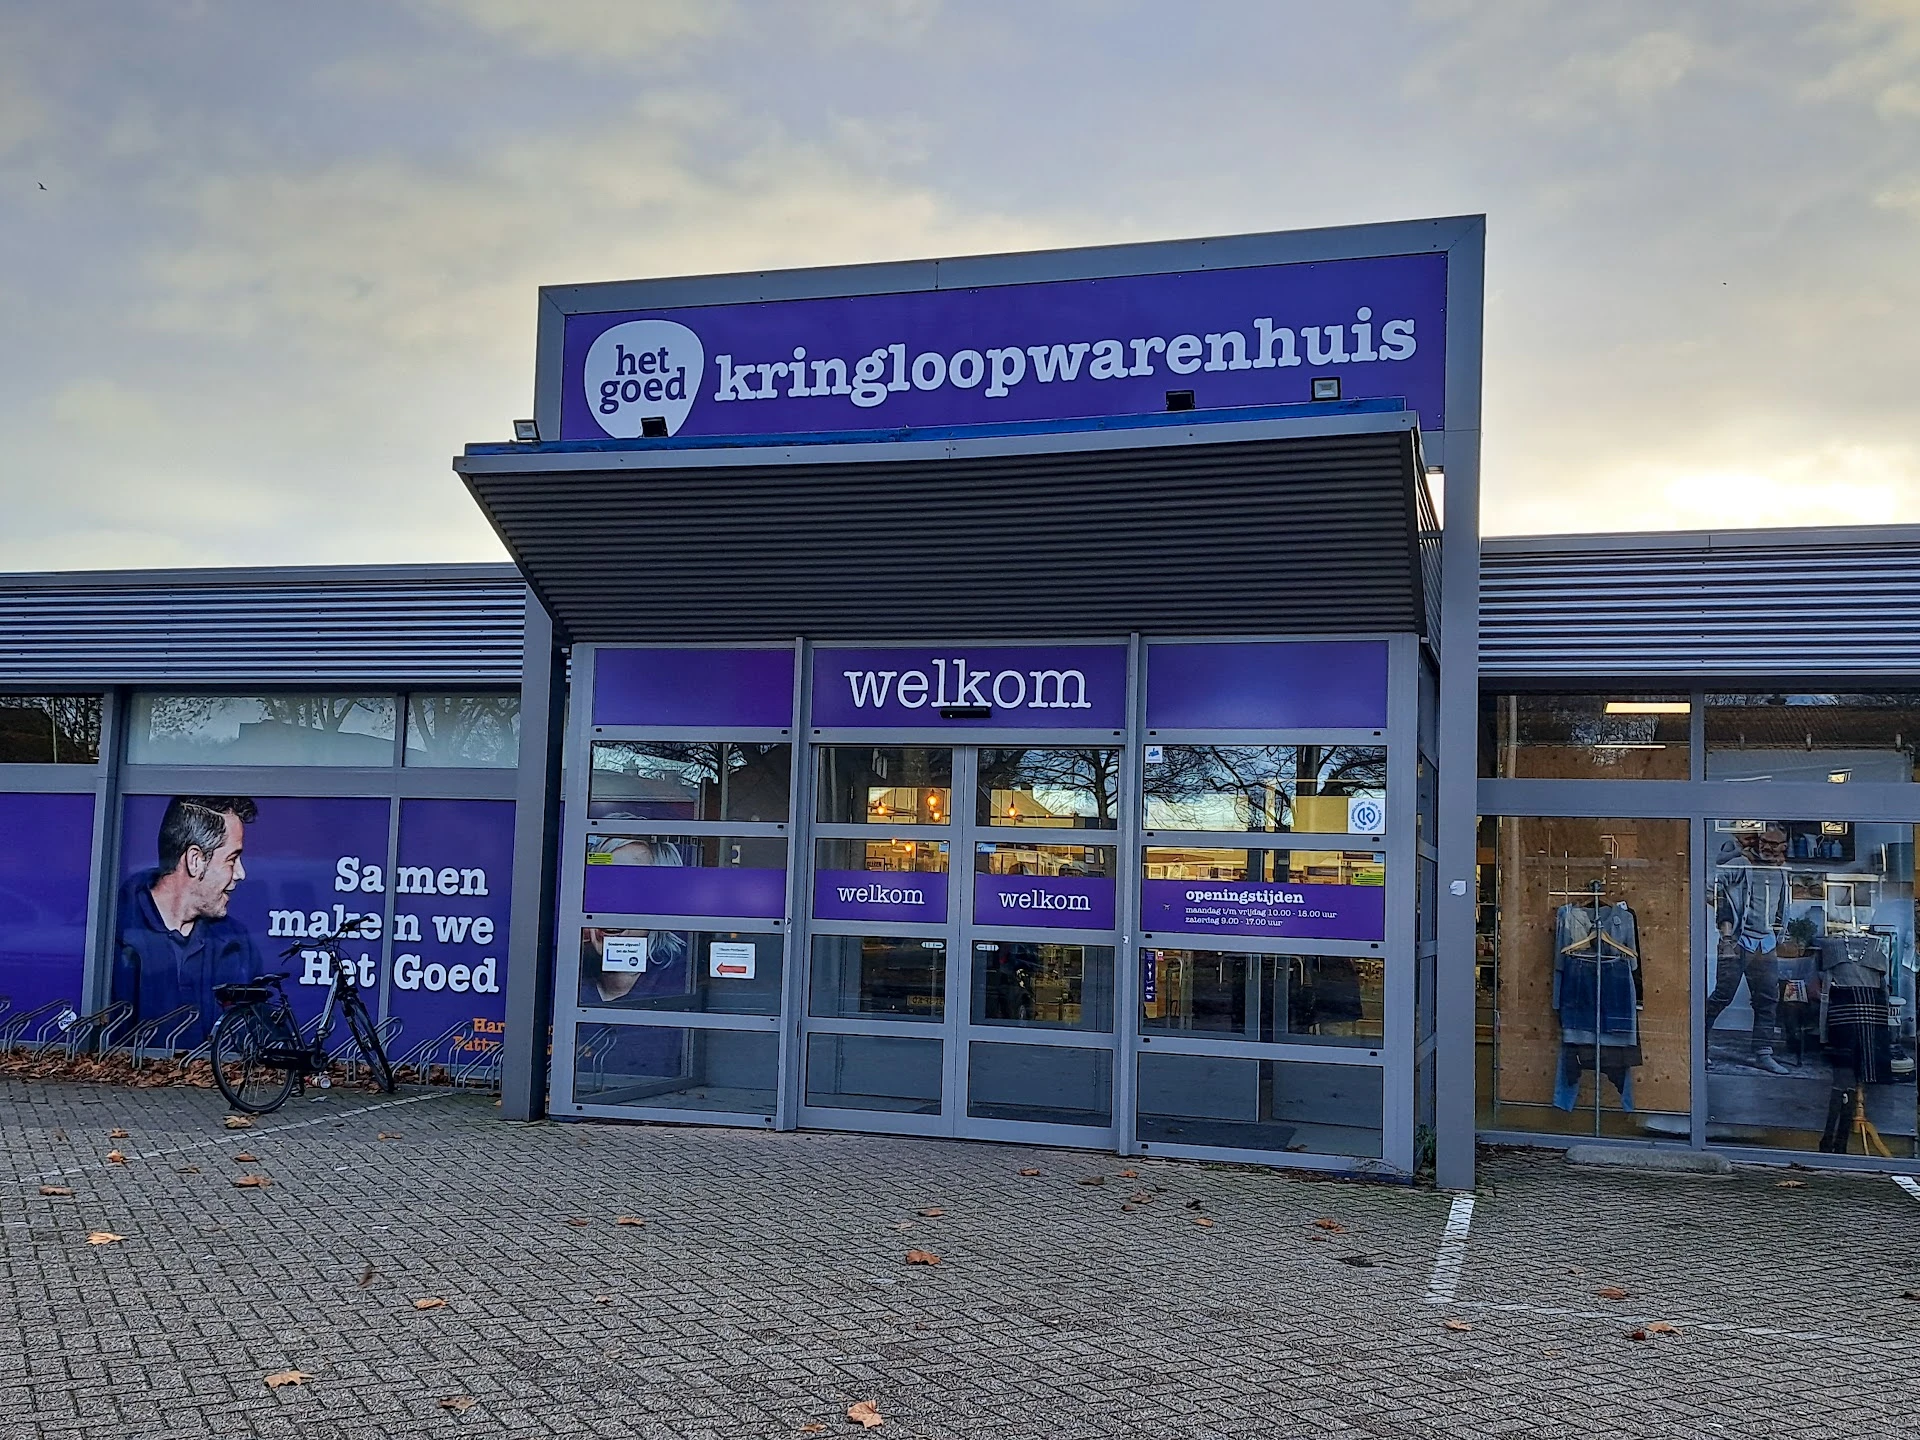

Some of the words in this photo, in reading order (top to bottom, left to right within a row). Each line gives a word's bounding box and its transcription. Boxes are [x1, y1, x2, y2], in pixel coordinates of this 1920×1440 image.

[615, 344, 670, 376] het
[713, 305, 1418, 409] kringloopwarenhuis
[598, 367, 687, 414] goed
[843, 658, 1092, 709] welkom
[334, 856, 489, 896] Samen
[836, 884, 925, 905] welkom
[998, 889, 1091, 911] welkom
[1185, 889, 1305, 908] openingstijden
[268, 904, 422, 942] maken
[431, 915, 494, 945] we
[1185, 907, 1221, 916] maandag
[1222, 907, 1238, 917] t/m
[1238, 908, 1267, 918] vrijdag
[1268, 909, 1291, 918] 10.00
[1321, 911, 1338, 919] uur
[1220, 917, 1239, 926] 9.00
[1245, 918, 1267, 927] 17.00
[299, 949, 376, 988] Het
[393, 953, 500, 993] Goed
[472, 1017, 506, 1034] Har
